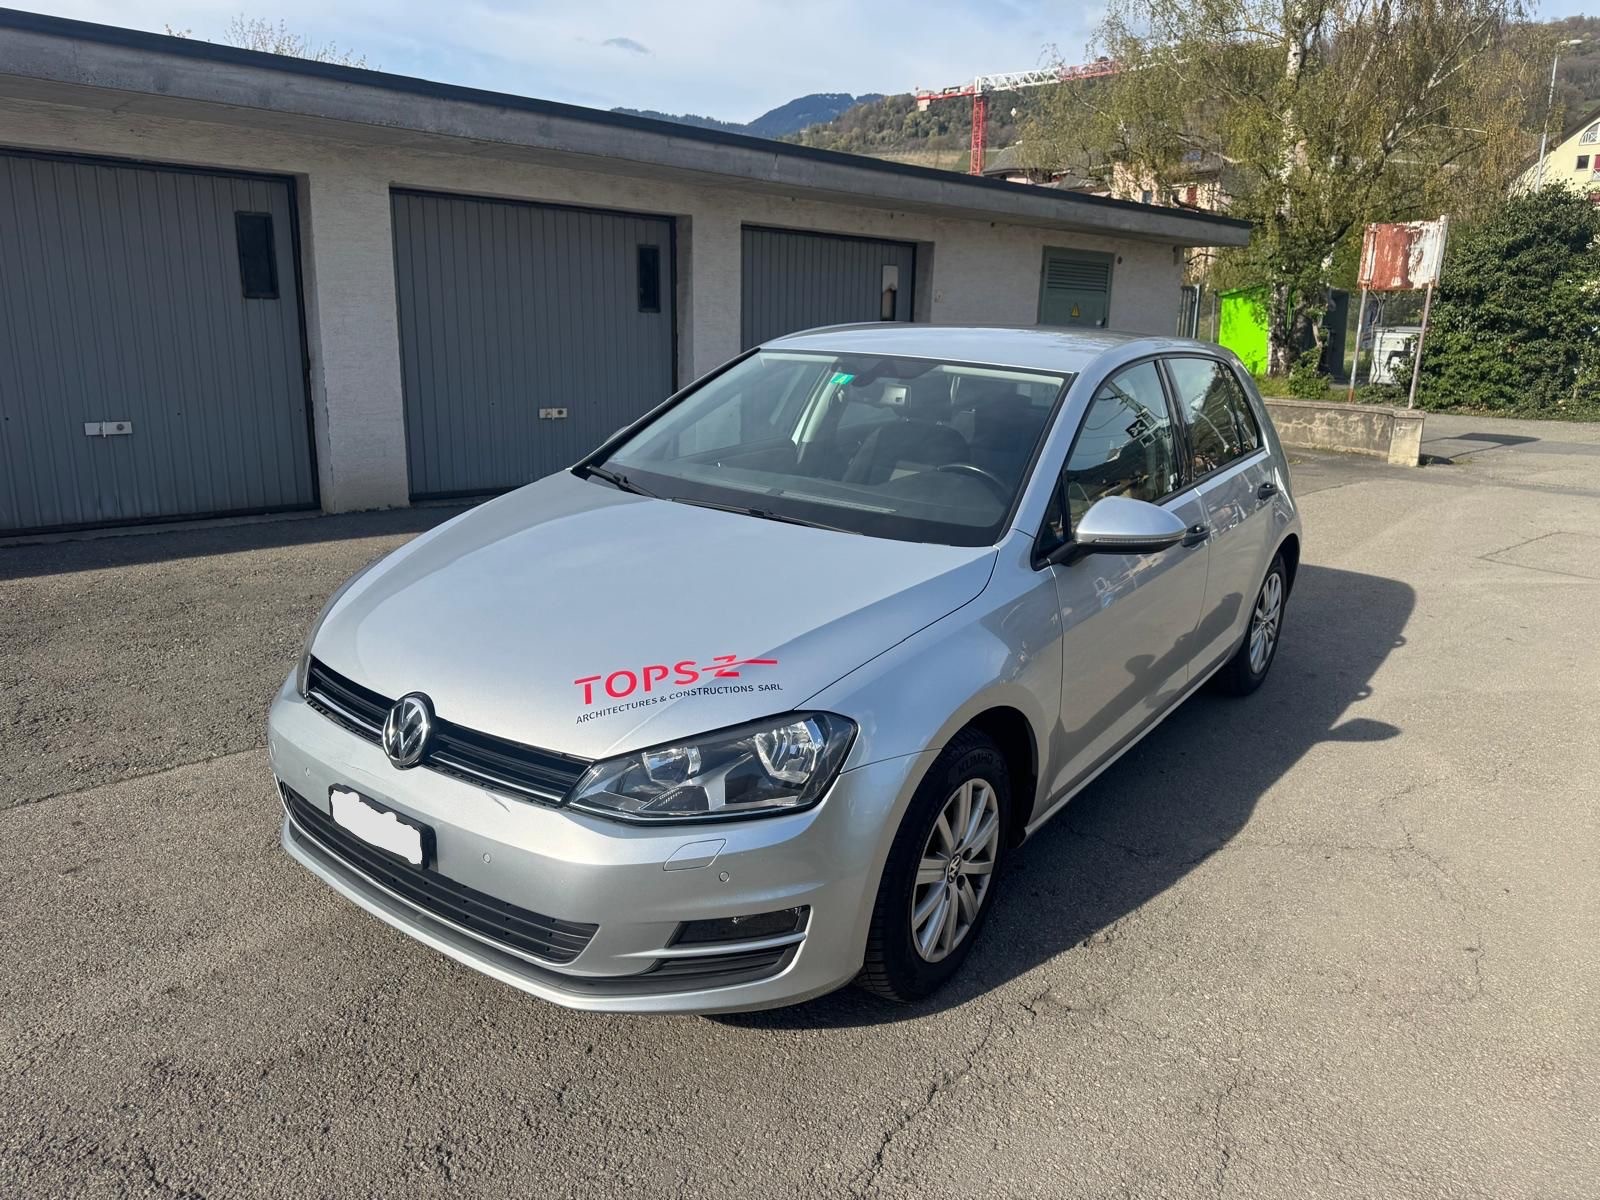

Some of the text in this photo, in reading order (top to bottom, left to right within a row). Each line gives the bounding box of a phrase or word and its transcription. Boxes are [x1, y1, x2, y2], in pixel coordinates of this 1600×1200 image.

[574, 660, 700, 704] TOPS
[576, 683, 783, 724] ARCHITECTURES & CONSTRUCTIONS SARL
